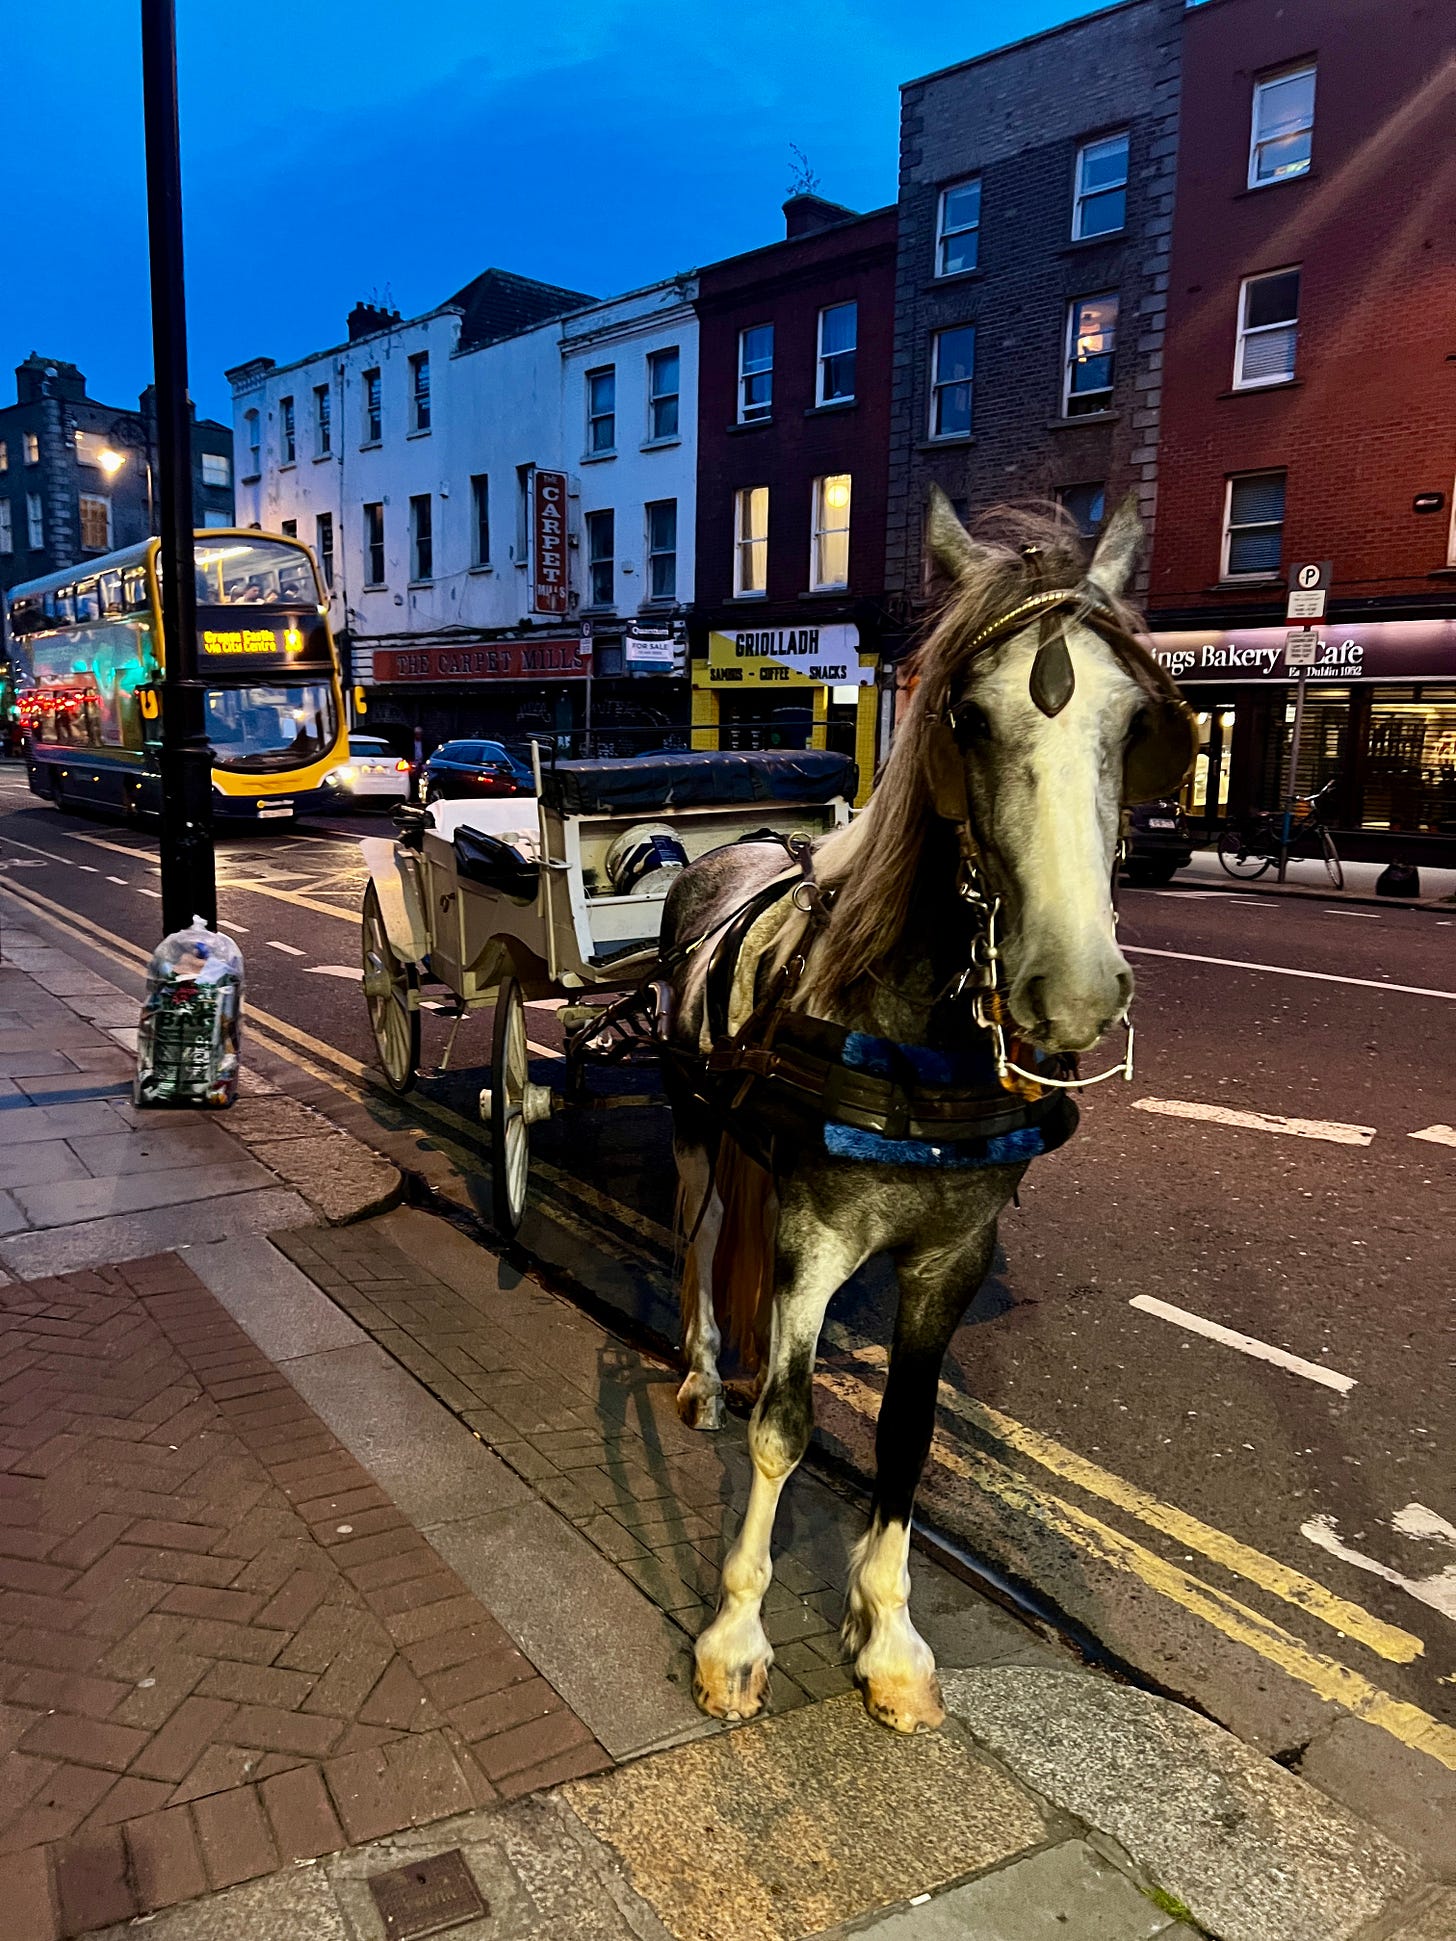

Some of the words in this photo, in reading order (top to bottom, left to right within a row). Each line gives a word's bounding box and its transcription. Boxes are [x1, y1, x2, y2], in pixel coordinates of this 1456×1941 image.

[541, 487, 561, 582] CARPET
[1306, 569, 1315, 585] P
[736, 629, 819, 657] GRIOLLADH
[398, 655, 429, 675] THE
[438, 650, 511, 674] CARPET
[521, 647, 583, 672] MILLS
[759, 667, 790, 681] COFFEE
[809, 665, 847, 680] SNACKS
[1151, 648, 1196, 676] ings
[1201, 644, 1281, 674] Bakery
